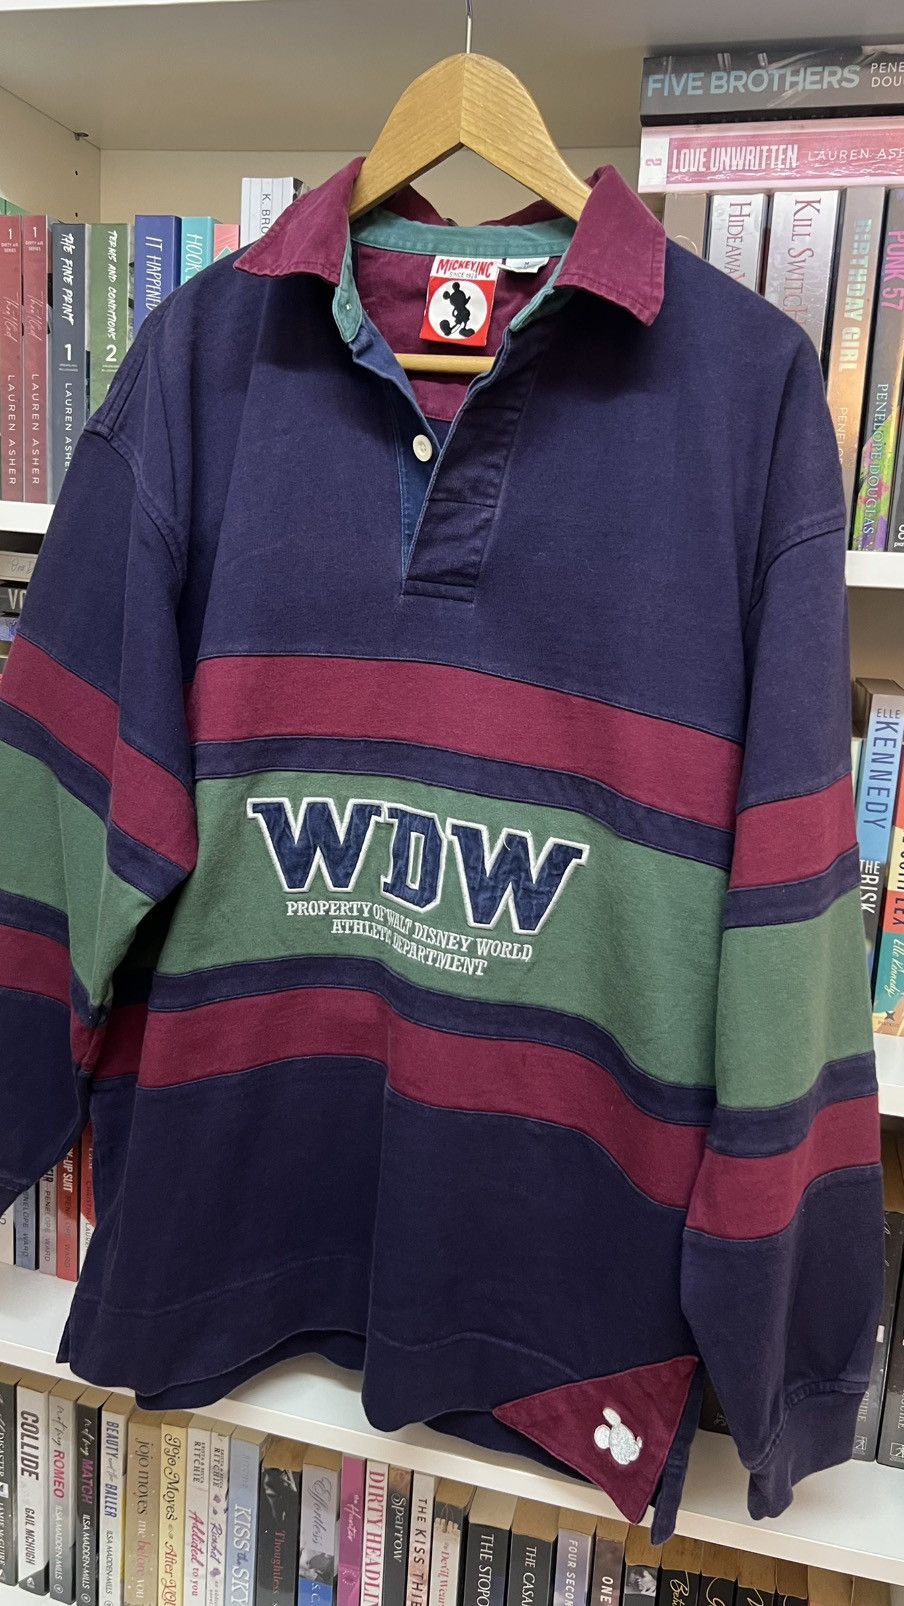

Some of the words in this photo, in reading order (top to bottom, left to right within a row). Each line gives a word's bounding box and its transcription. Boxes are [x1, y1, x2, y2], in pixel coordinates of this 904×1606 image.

[647, 72, 704, 97] FIVE
[709, 64, 861, 94] BROTHERS
[671, 148, 707, 173] LOVE
[710, 144, 798, 172] UNWRITTEN
[807, 149, 869, 161] LAUREN
[262, 193, 272, 205] K.
[791, 198, 822, 241] KILL
[60, 233, 76, 255] THE
[107, 230, 118, 263] TERMS
[145, 236, 163, 252] IT
[185, 233, 203, 275] HOOK
[883, 231, 904, 282] PUNK
[60, 257, 73, 286] FINE
[107, 263, 118, 283] AND
[450, 271, 464, 279] SINCE
[844, 218, 873, 321] BIRTHDAY
[61, 287, 75, 326] PRINT
[107, 286, 117, 340] CONDITIONS
[881, 286, 904, 311] 57
[64, 343, 72, 361] 1
[105, 344, 117, 362] 2
[839, 326, 861, 372] GIRL
[7, 374, 16, 431] LAUREN
[31, 373, 40, 431] LAUREN
[65, 383, 73, 431] LAUREN
[871, 383, 889, 461] PENELOPE
[8, 440, 17, 485] ASHER
[31, 440, 40, 485] ASHER
[64, 438, 73, 471] ASHE
[863, 463, 881, 534] DOUGLAS
[876, 708, 901, 719] ELLE
[863, 720, 899, 830] KENNEDY
[247, 797, 590, 935] WDW
[859, 859, 881, 875] THE
[859, 874, 880, 914] RISK
[286, 900, 372, 917] PROPERTY
[373, 904, 387, 921] OF
[386, 909, 413, 935] WALT
[413, 922, 475, 952] DISNEY
[476, 938, 533, 962] WORLD
[391, 936, 488, 976] DEPARTMENT
[63, 1173, 73, 1193] SUIT
[20, 1410, 40, 1481] COLLIDE
[106, 1420, 120, 1459] BEAUTY
[135, 1438, 153, 1468] jojo
[163, 1433, 182, 1467] Jojo
[53, 1449, 65, 1499] ROMEO
[193, 1441, 201, 1483] RITCHIE
[81, 1458, 94, 1504] MATCH
[133, 1471, 149, 1515] moyes
[162, 1466, 180, 1521] Moyes
[367, 1470, 385, 1529] DIRTY
[25, 1507, 35, 1529] GAIL
[55, 1505, 63, 1520] ILSA
[104, 1483, 118, 1518] BALLER
[308, 1477, 333, 1545] Effortless
[417, 1498, 428, 1524] THE
[82, 1514, 91, 1528] ILSA
[106, 1529, 114, 1544] ILSA
[138, 1520, 146, 1537] me
[188, 1509, 206, 1567] Addicted
[233, 1503, 251, 1552] KISS
[344, 1503, 361, 1542] Hunter
[391, 1493, 406, 1563] Sparrow
[25, 1529, 36, 1565] MCHUGH
[82, 1530, 91, 1589] MADDEN-MILLS
[164, 1541, 177, 1578] After
[271, 1530, 287, 1595] Thoughtless
[413, 1528, 427, 1565] KISS
[437, 1550, 450, 1580] Devil
[480, 1533, 495, 1562] THE
[525, 1545, 537, 1568] THE
[567, 1539, 579, 1568] FOUR
[105, 1545, 114, 1594] MADDEN-MILLS
[191, 1579, 199, 1596] you
[193, 1567, 200, 1578] to
[230, 1565, 250, 1606] SKY
[136, 1579, 145, 1599] you
[600, 1575, 614, 1605] ONE
